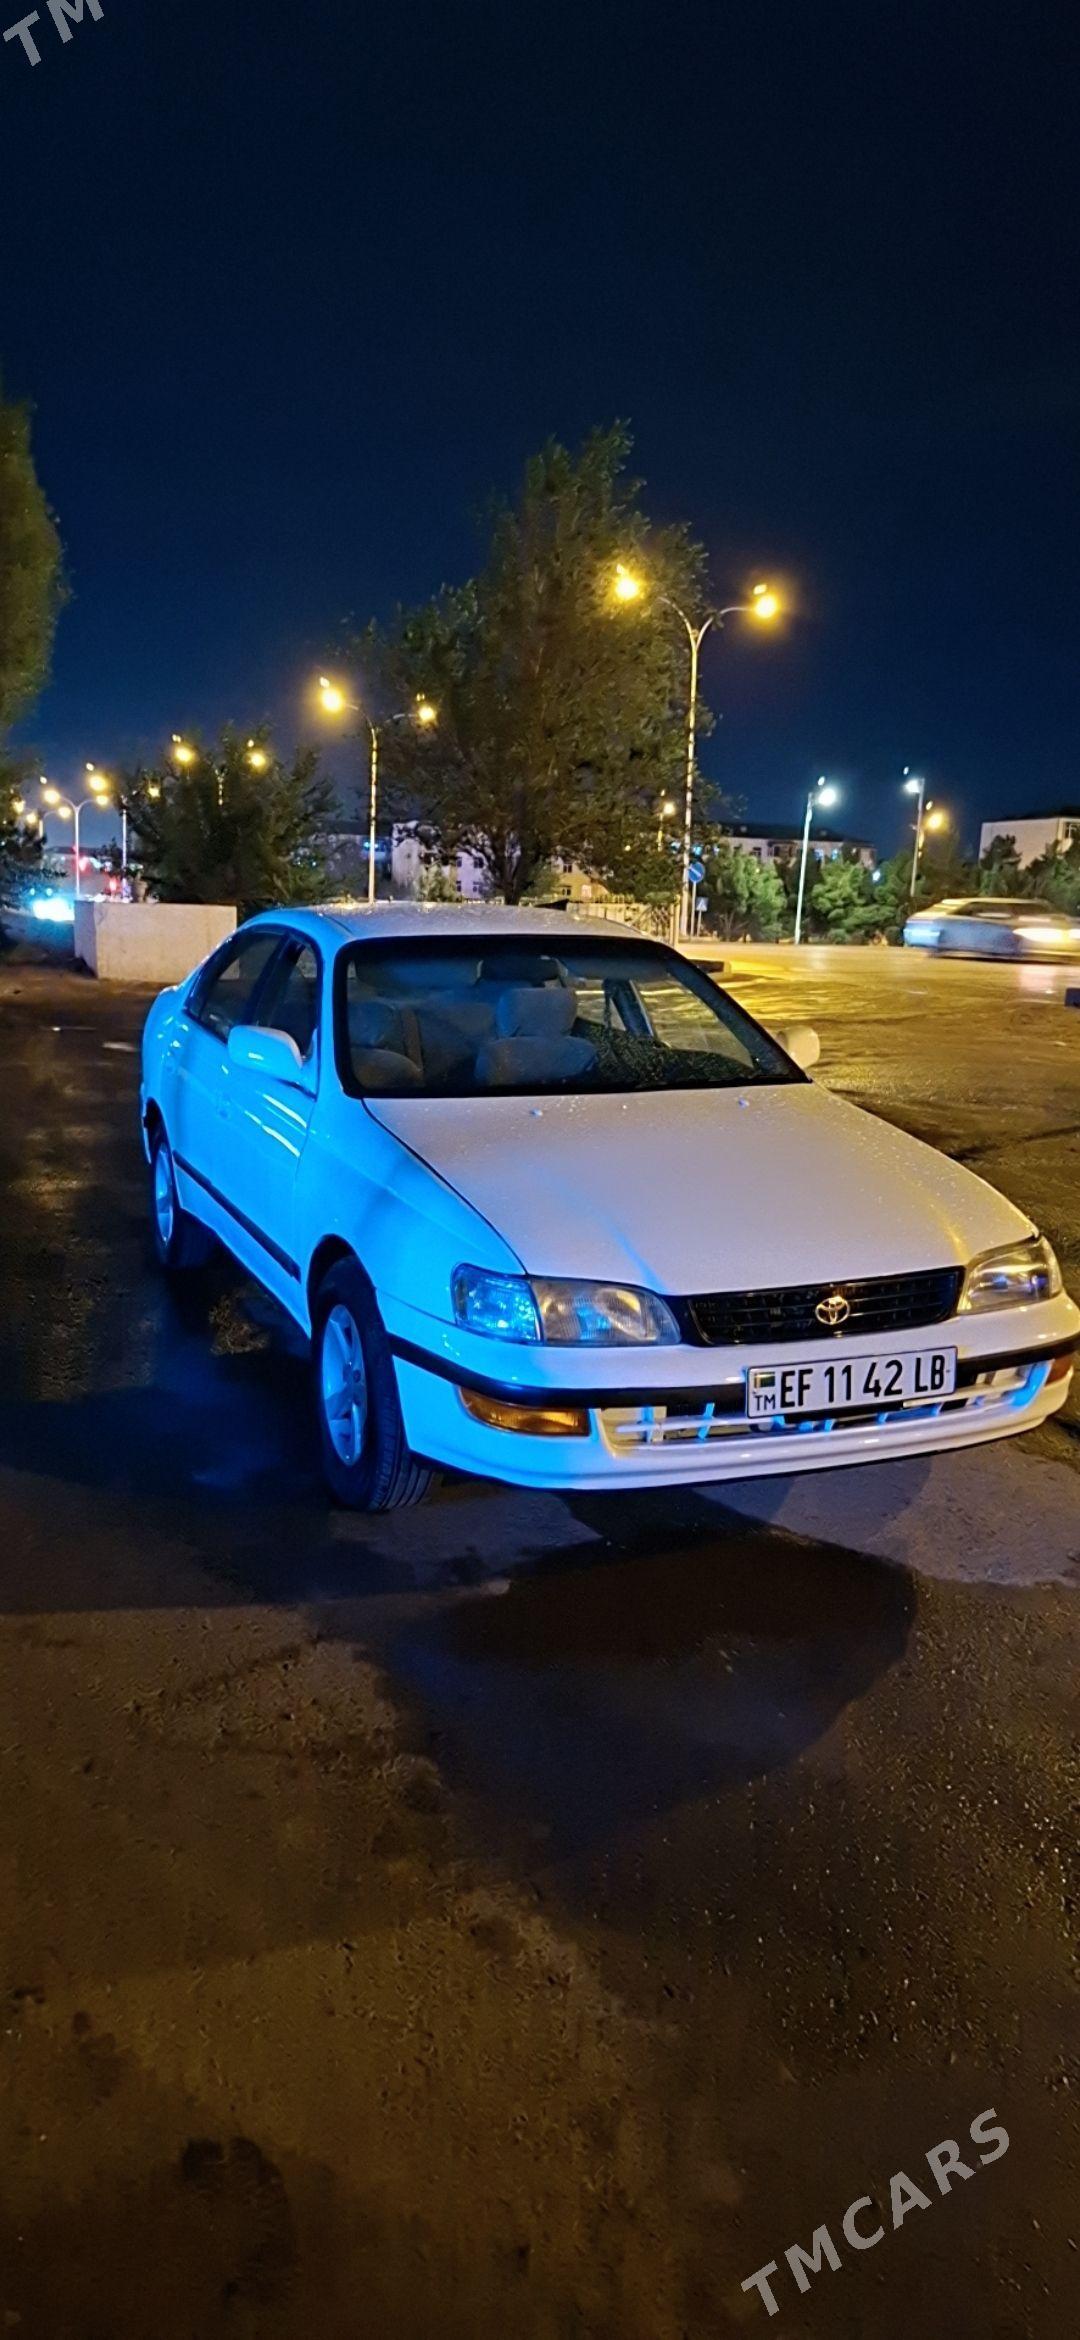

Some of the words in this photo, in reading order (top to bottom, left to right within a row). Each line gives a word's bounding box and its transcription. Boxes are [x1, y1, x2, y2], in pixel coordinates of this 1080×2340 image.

[780, 1369, 813, 1408] EF
[824, 1365, 852, 1402] 11
[863, 1360, 903, 1397] 42
[914, 1355, 945, 1393] LB
[754, 1394, 776, 1411] TM
